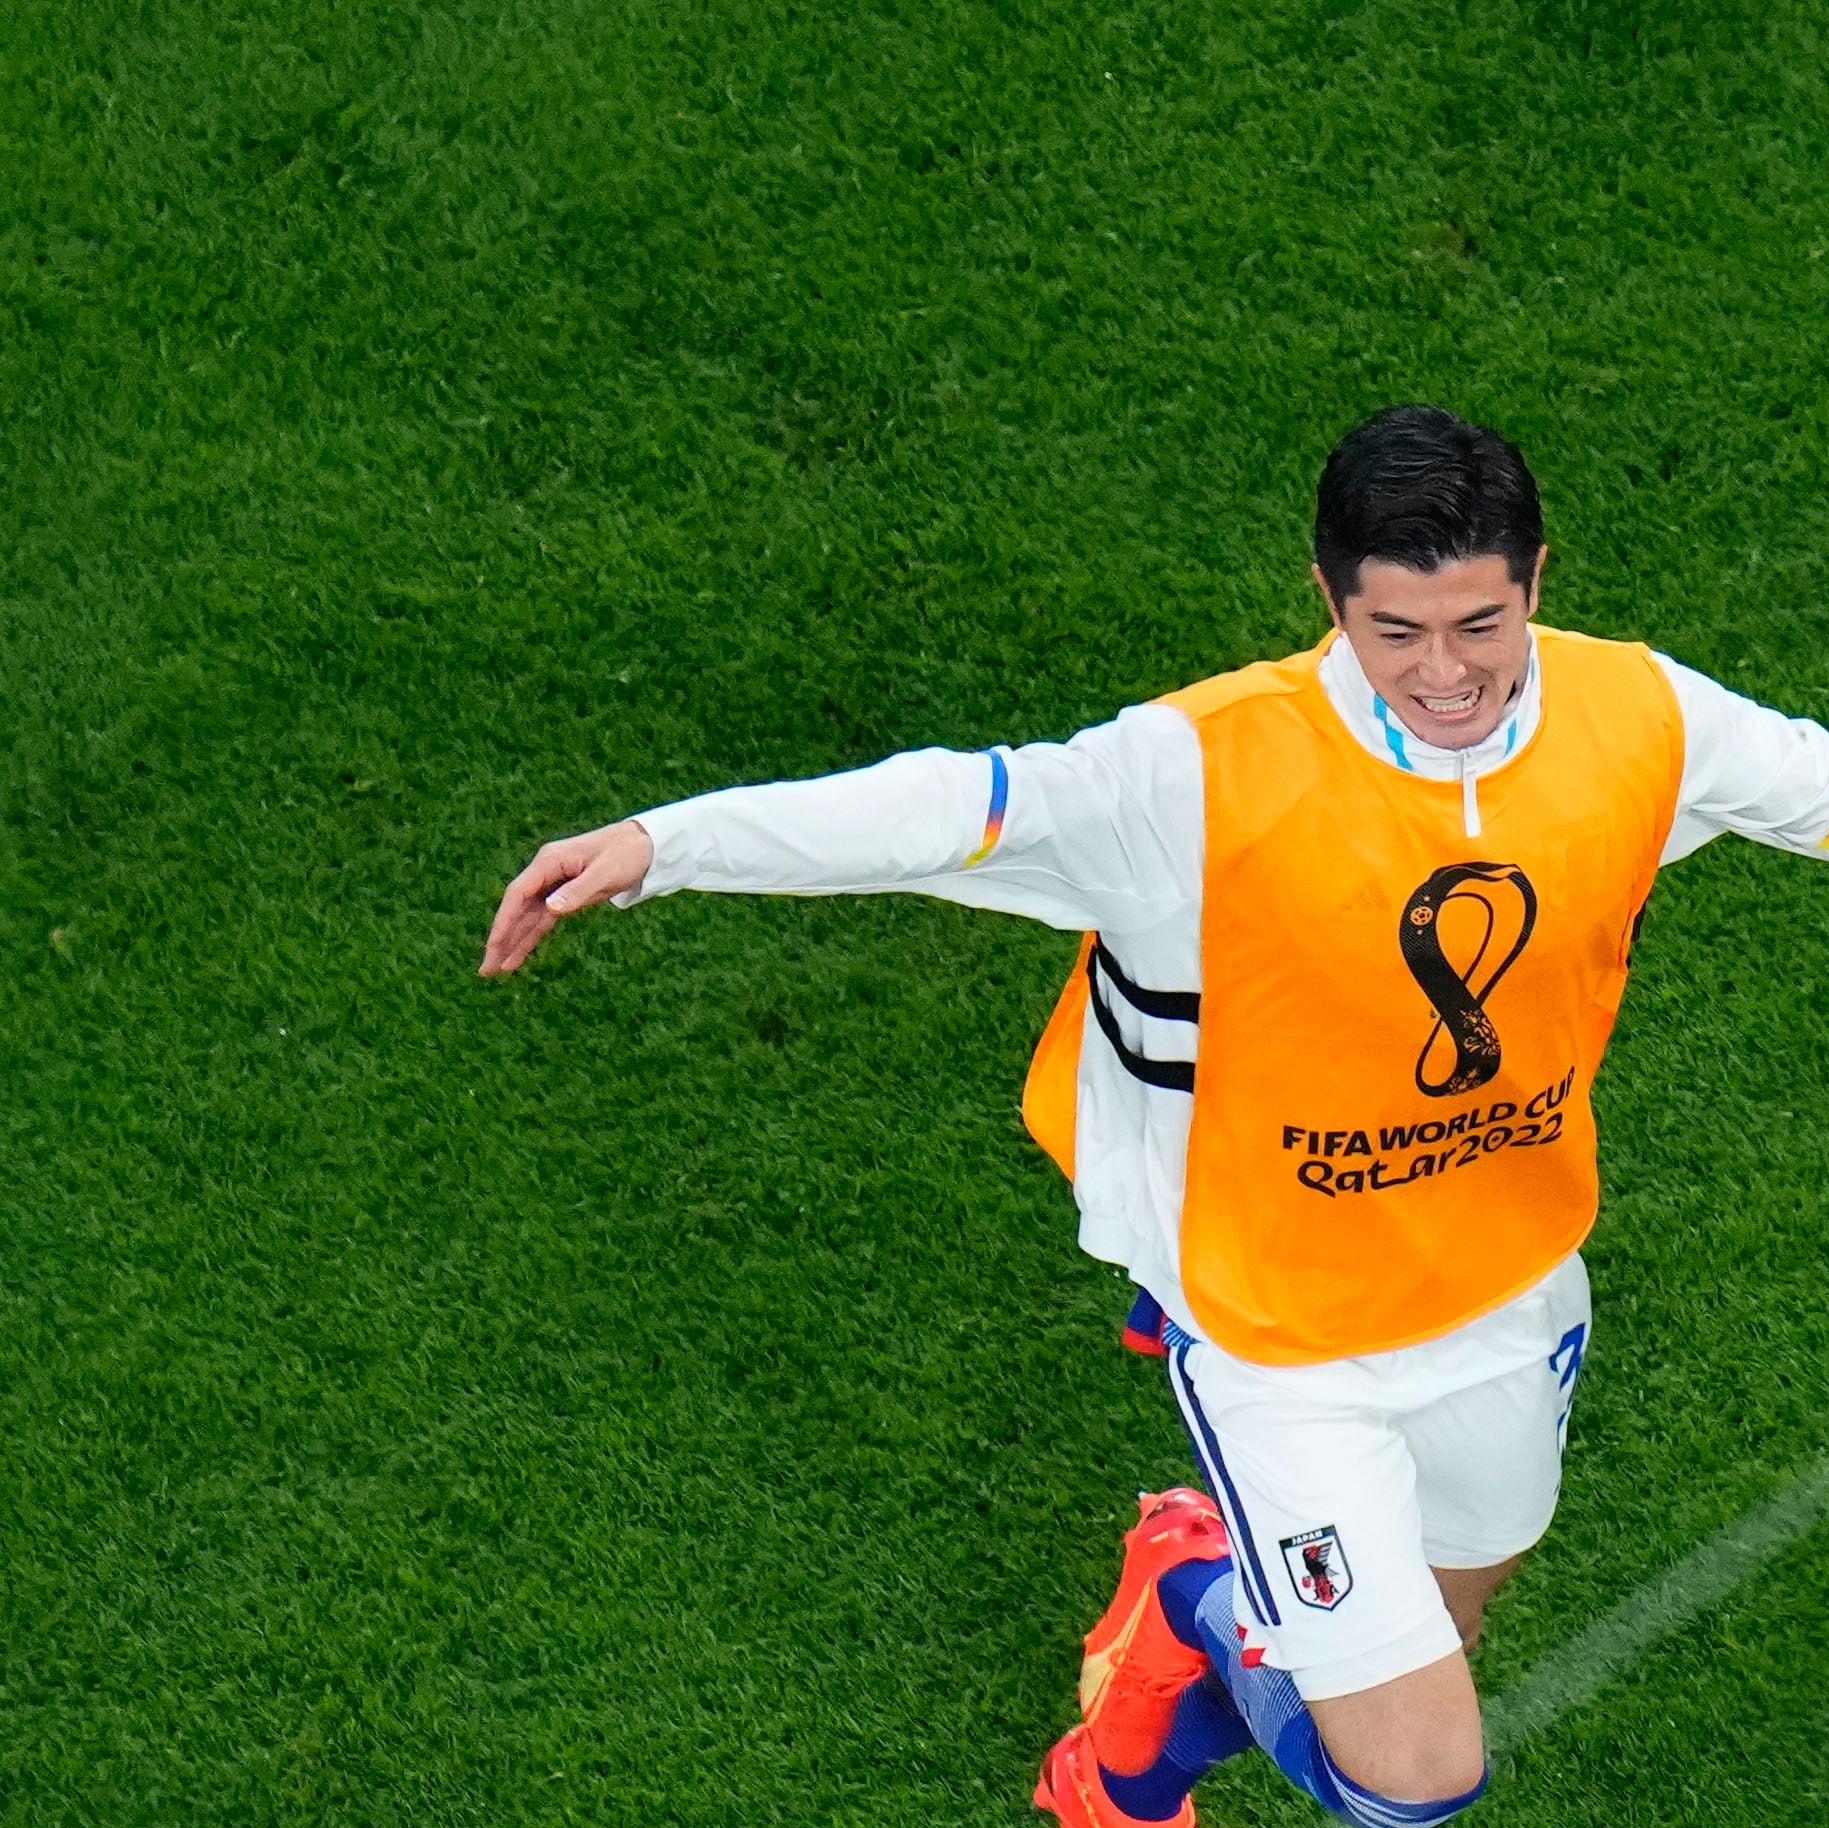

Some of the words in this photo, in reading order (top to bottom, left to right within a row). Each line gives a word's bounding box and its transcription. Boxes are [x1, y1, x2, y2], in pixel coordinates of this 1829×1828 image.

[1282, 1125, 1373, 1157] FIFA
[1379, 1102, 1518, 1150] WORLD
[1524, 1065, 1575, 1119] CUP
